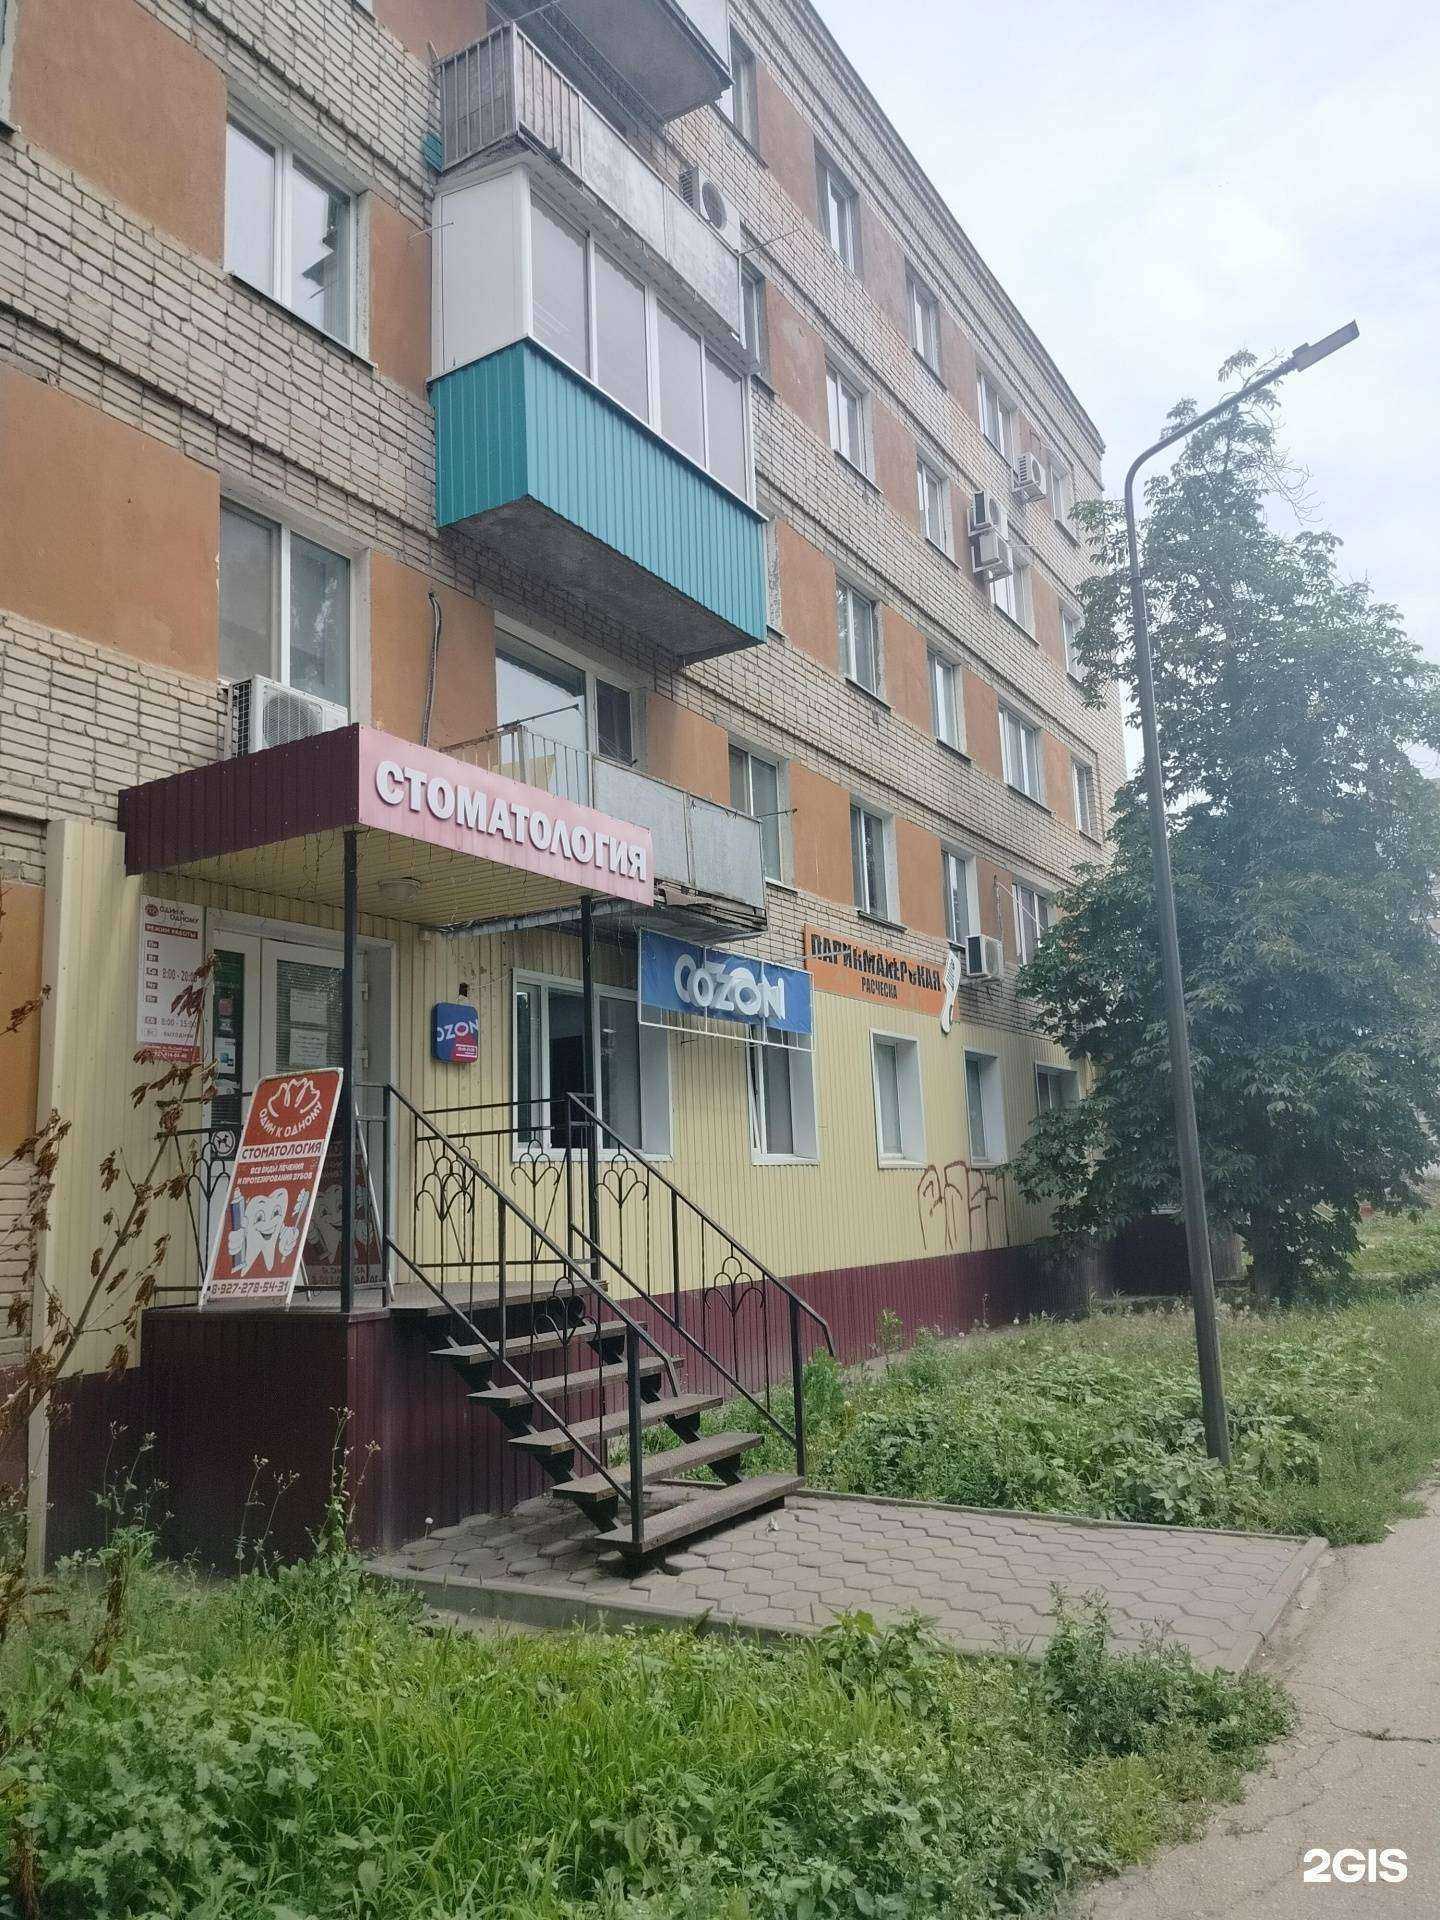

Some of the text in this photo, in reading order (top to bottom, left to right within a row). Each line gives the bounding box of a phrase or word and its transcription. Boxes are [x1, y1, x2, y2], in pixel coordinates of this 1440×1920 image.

[375, 760, 647, 882] СТОМАТОЛОГИЯ
[861, 977, 898, 1000] РАСЧЕСКА
[259, 1101, 322, 1138] ОДИН К ОДНОМУ
[242, 1141, 321, 1159] СТОМАТОЛОГИЯ
[279, 1163, 304, 1172] ЛЕЧЕНИЯ
[293, 1172, 313, 1180] ЗУБОВ
